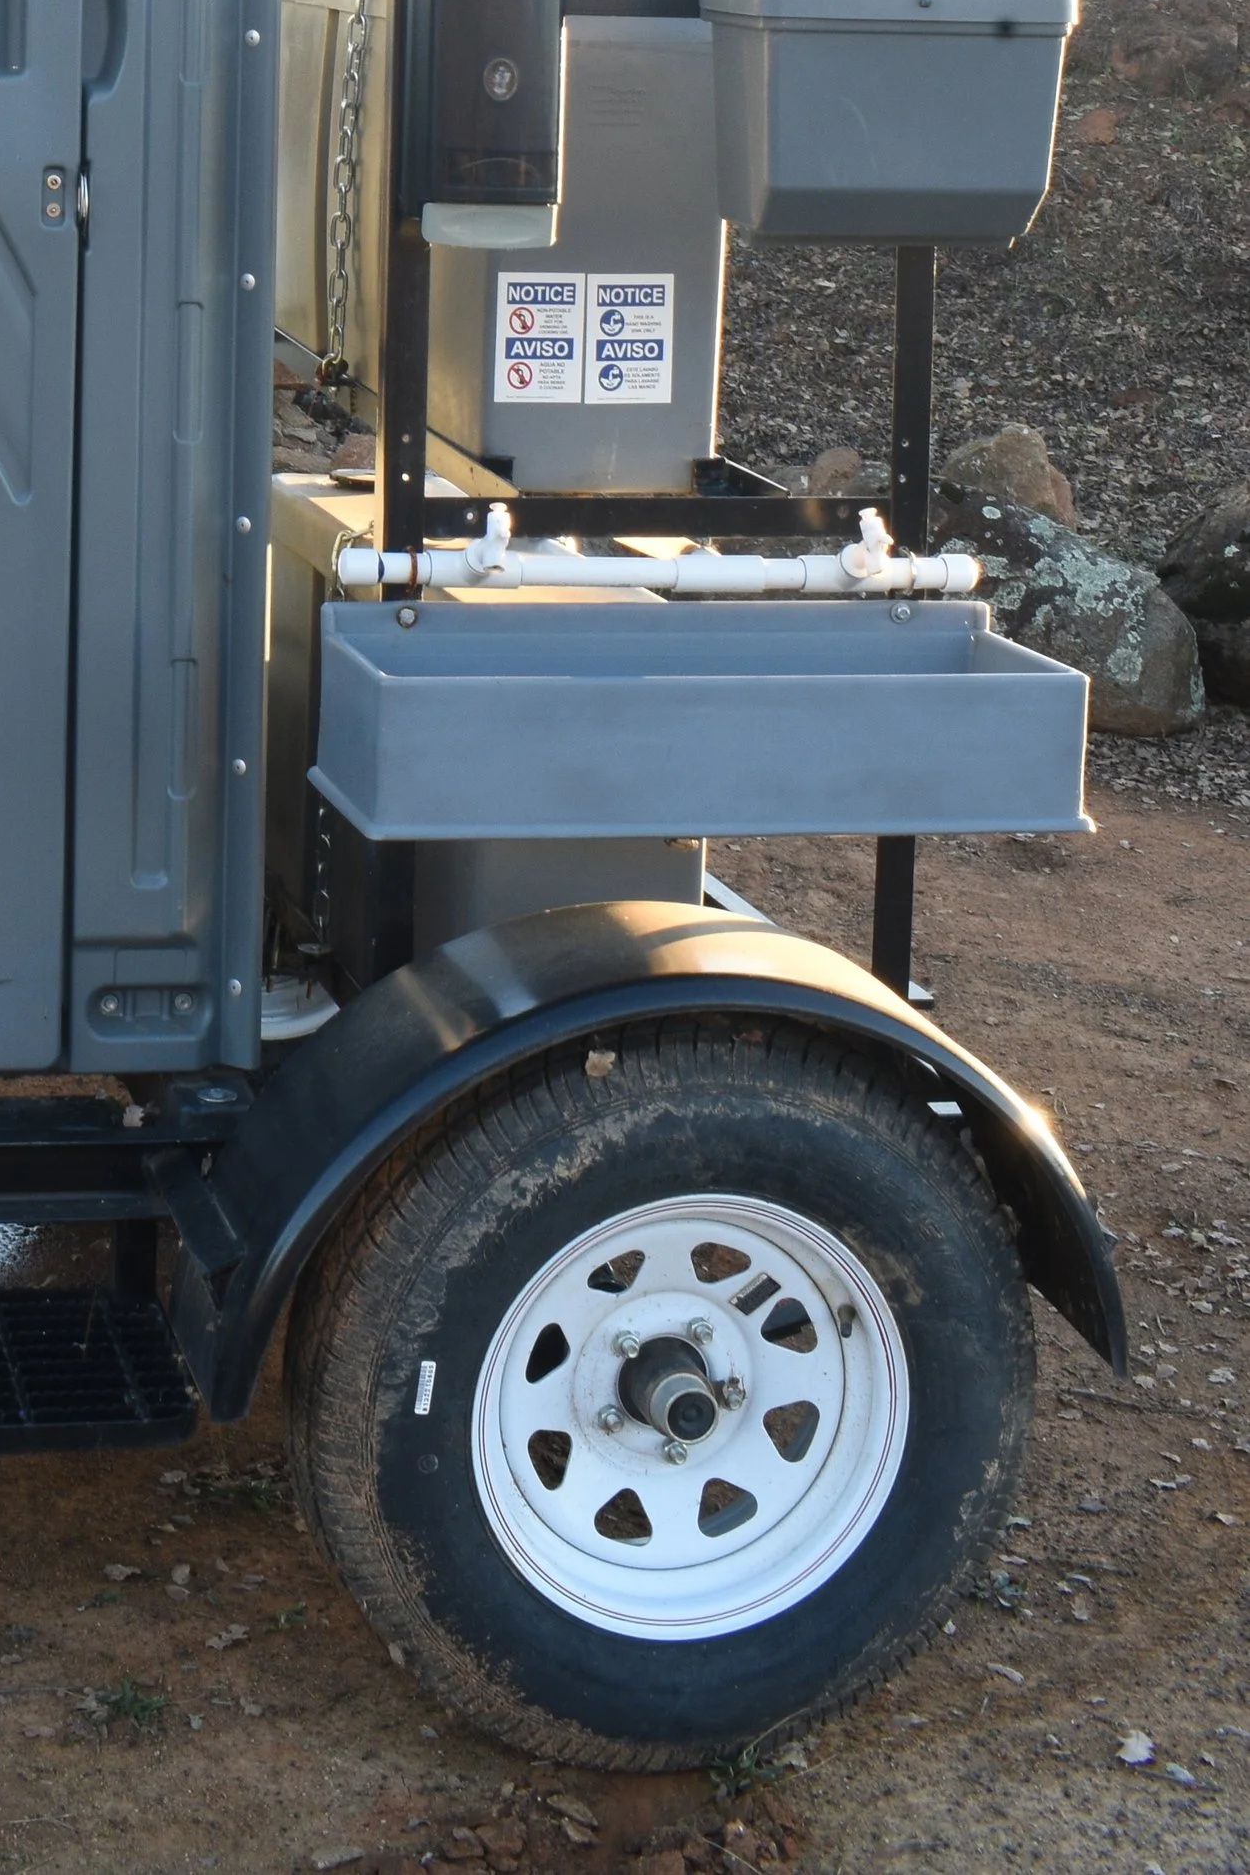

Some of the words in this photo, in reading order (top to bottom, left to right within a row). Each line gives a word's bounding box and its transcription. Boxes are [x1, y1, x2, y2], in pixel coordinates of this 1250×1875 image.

[508, 285, 575, 302] NOTICE
[598, 287, 664, 304] NOTICE
[510, 340, 569, 357] AVISO
[601, 342, 659, 359] AVISO
